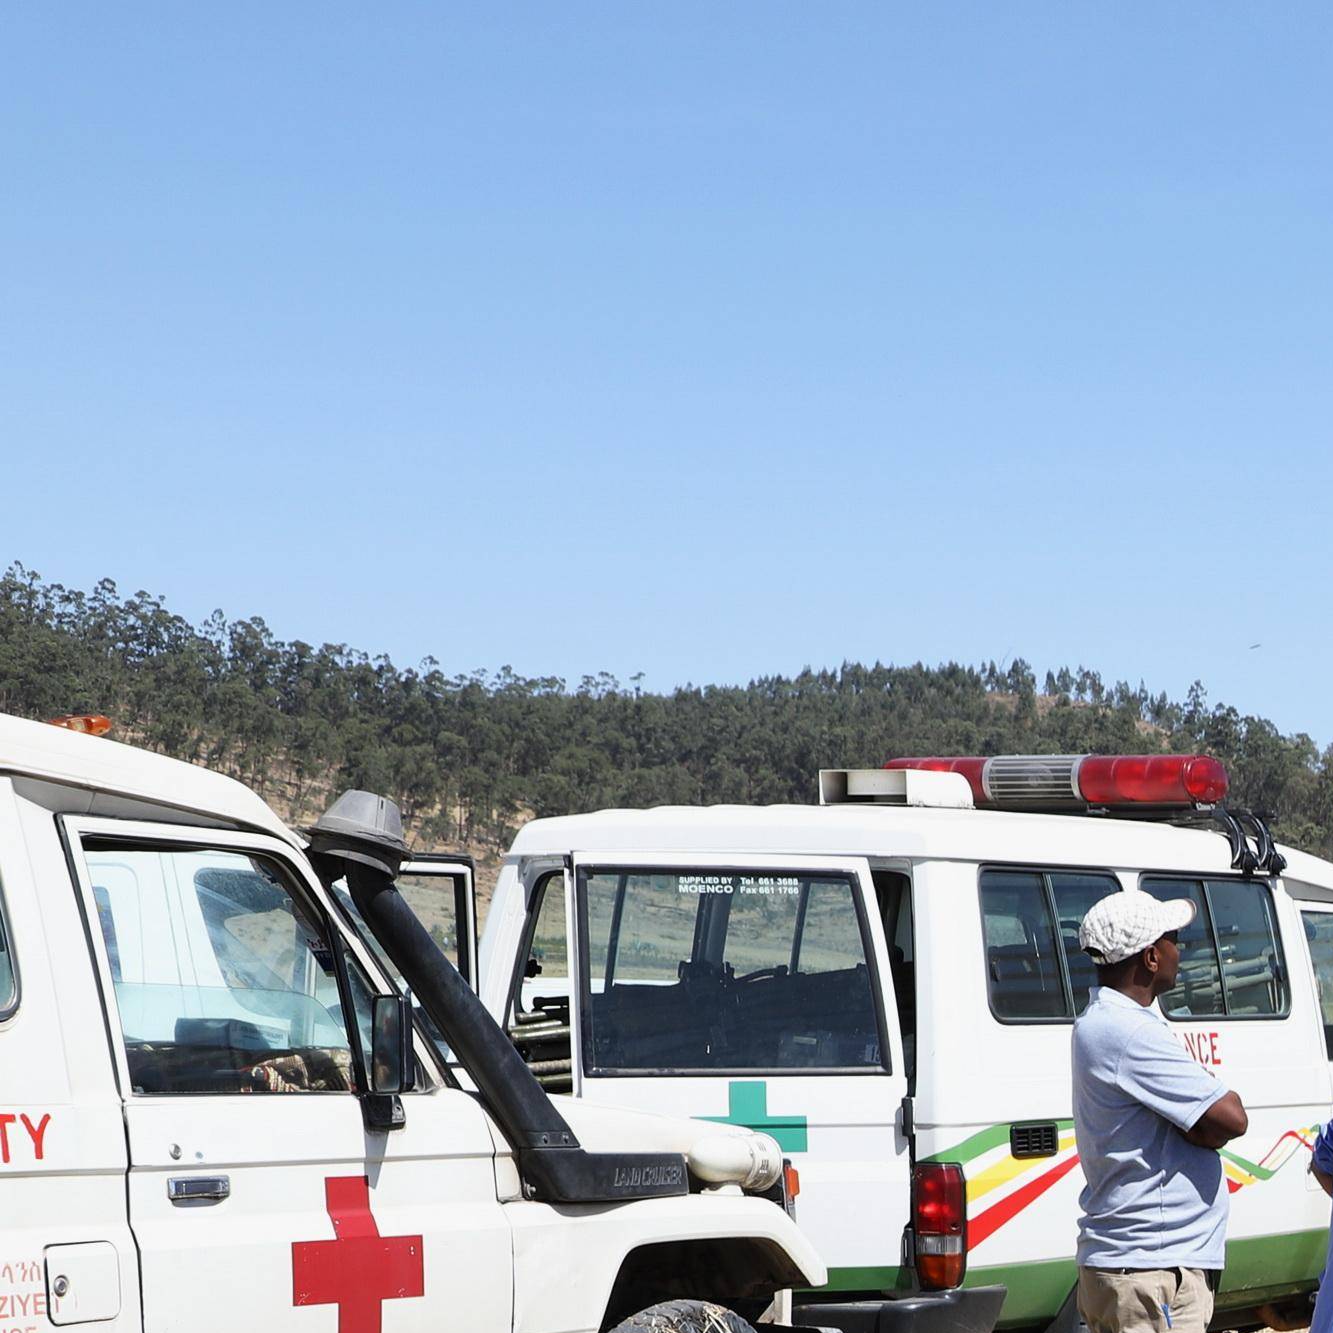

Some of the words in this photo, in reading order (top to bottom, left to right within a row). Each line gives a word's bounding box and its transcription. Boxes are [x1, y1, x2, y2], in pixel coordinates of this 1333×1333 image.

[679, 876, 719, 884] SUPPLIED
[721, 876, 732, 884] BY
[740, 877, 754, 885] Tel
[679, 885, 733, 894] MOENCO
[740, 886, 757, 894] Fax
